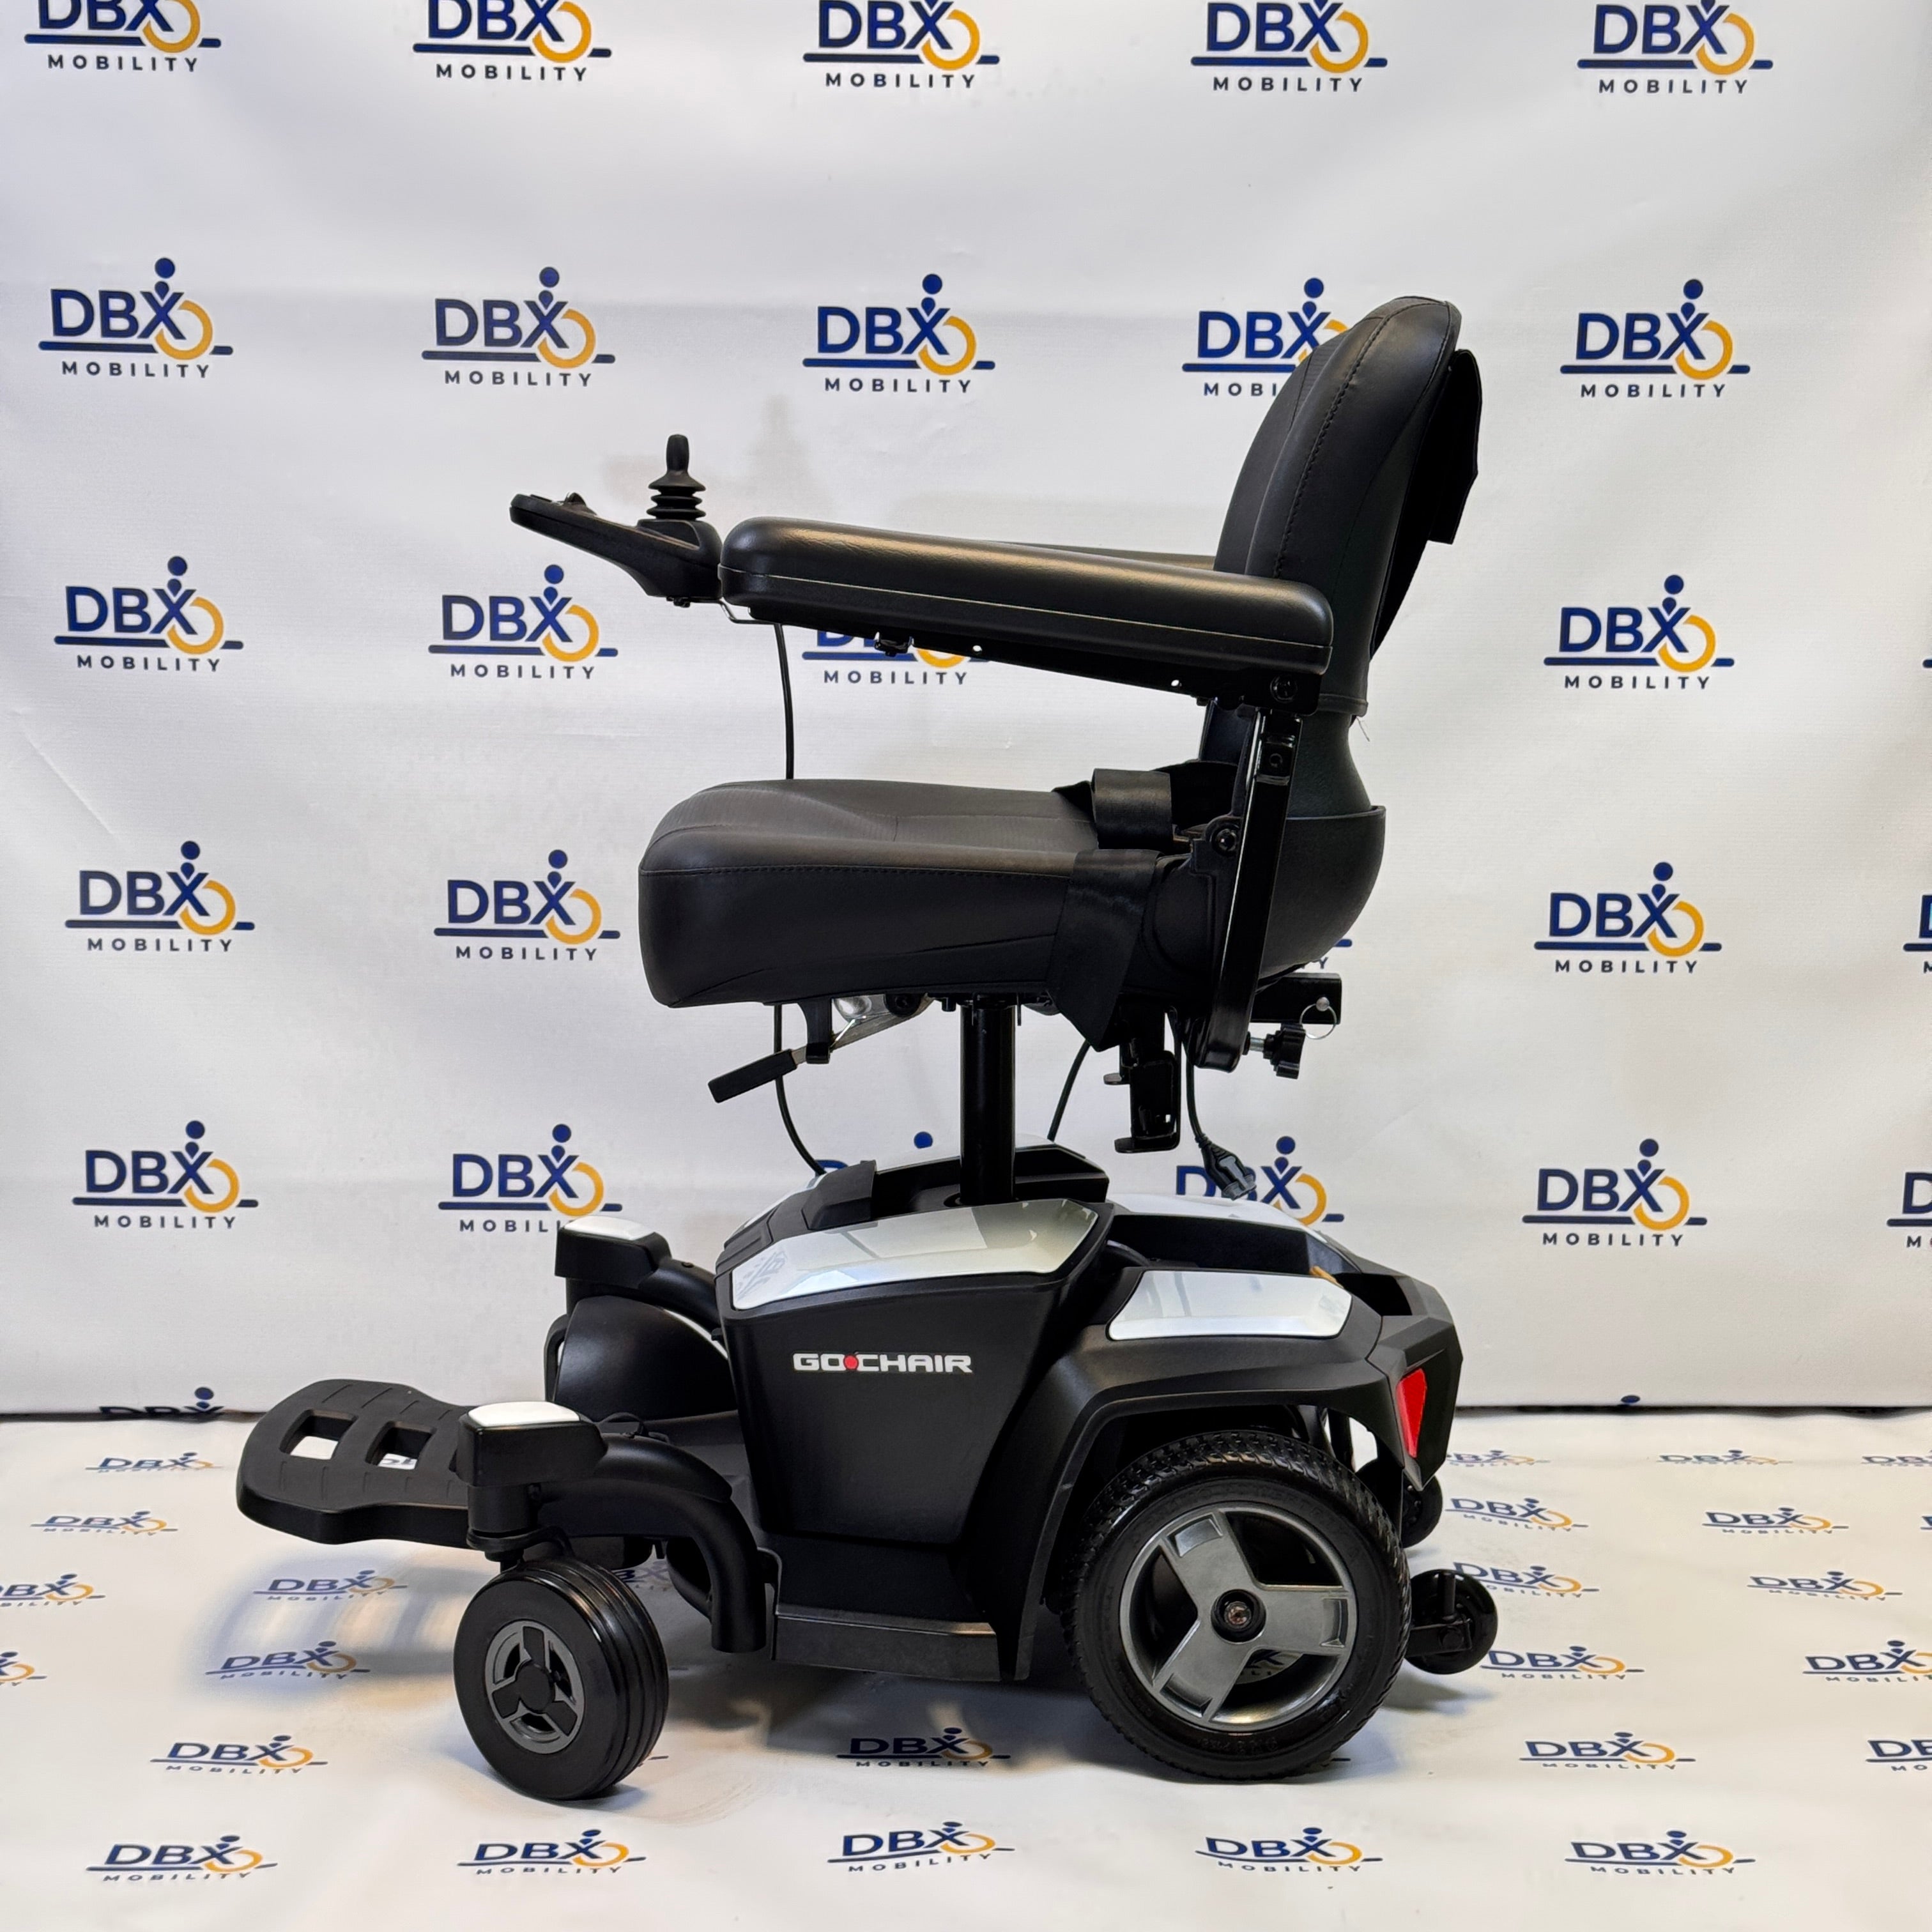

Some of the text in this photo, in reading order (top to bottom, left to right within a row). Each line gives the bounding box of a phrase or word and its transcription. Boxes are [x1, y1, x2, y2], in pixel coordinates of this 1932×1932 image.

[428, 0, 564, 42] DBX
[818, 0, 954, 50] DBX
[1207, 2, 1342, 52] DBX
[1593, 4, 1729, 55] DBX
[47, 54, 199, 73] MOBILITY
[436, 64, 587, 82] MOBILITY
[825, 73, 975, 89] MOBILITY
[1213, 77, 1363, 93] MOBILITY
[1598, 79, 1748, 95] MOBILITY
[50, 289, 187, 340] DBX
[435, 298, 569, 349] DBX
[817, 306, 949, 356] DBX
[1198, 310, 1331, 358] DBX
[1576, 312, 1710, 361] DBX
[61, 361, 210, 379] MOBILITY
[444, 370, 592, 387] MOBILITY
[825, 378, 972, 394] MOBILITY
[1203, 383, 1276, 396] MOBI
[1581, 384, 1727, 399] MOBILITY
[66, 586, 198, 635] DBX
[441, 595, 573, 643] DBX
[1558, 606, 1691, 653] DBX
[77, 655, 222, 672] MOBILITY
[450, 664, 595, 679] MOBILITY
[824, 670, 967, 685] MOBILITY
[1564, 675, 1711, 689] MOBILITY
[79, 870, 209, 916] DBX
[447, 878, 577, 926] DBX
[1549, 892, 1681, 938] DBX
[88, 938, 233, 953] MOBILITY
[456, 945, 599, 961] MOBILITY
[1555, 960, 1699, 974] MOBILITY
[85, 1149, 215, 1195] DBX
[452, 1153, 580, 1199] DBX
[1537, 1169, 1666, 1212] DBX
[94, 1215, 236, 1229] MOBILITY
[459, 1219, 561, 1232] MOBILI
[1542, 1233, 1683, 1246] MOBILITY
[1450, 1498, 1552, 1521] DBX
[45, 1516, 151, 1528] DBX
[1705, 1512, 1811, 1526] DBX
[1453, 1561, 1561, 1587] DBX
[0, 1582, 78, 1596] BX
[268, 1576, 378, 1591] DBX
[1750, 1576, 1862, 1591] DBX
[221, 1650, 339, 1669] DBX
[1489, 1650, 1603, 1668] DBX
[1805, 1650, 1926, 1670] DBX
[167, 1742, 294, 1761] DBX
[850, 1738, 969, 1754] DBX
[1526, 1740, 1652, 1757] DBX
[474, 1840, 606, 1860] DBX
[843, 1830, 970, 1856] DBX
[1206, 1837, 1336, 1857] DBX
[1571, 1842, 1708, 1860] DBX
[105, 1844, 243, 1864] DBX
[848, 1853, 991, 1872] MOBILITY
[1218, 1861, 1360, 1872] MOBILITY
[1591, 1866, 1735, 1874] MOBILITY
[103, 1873, 250, 1881] MOBILITY
